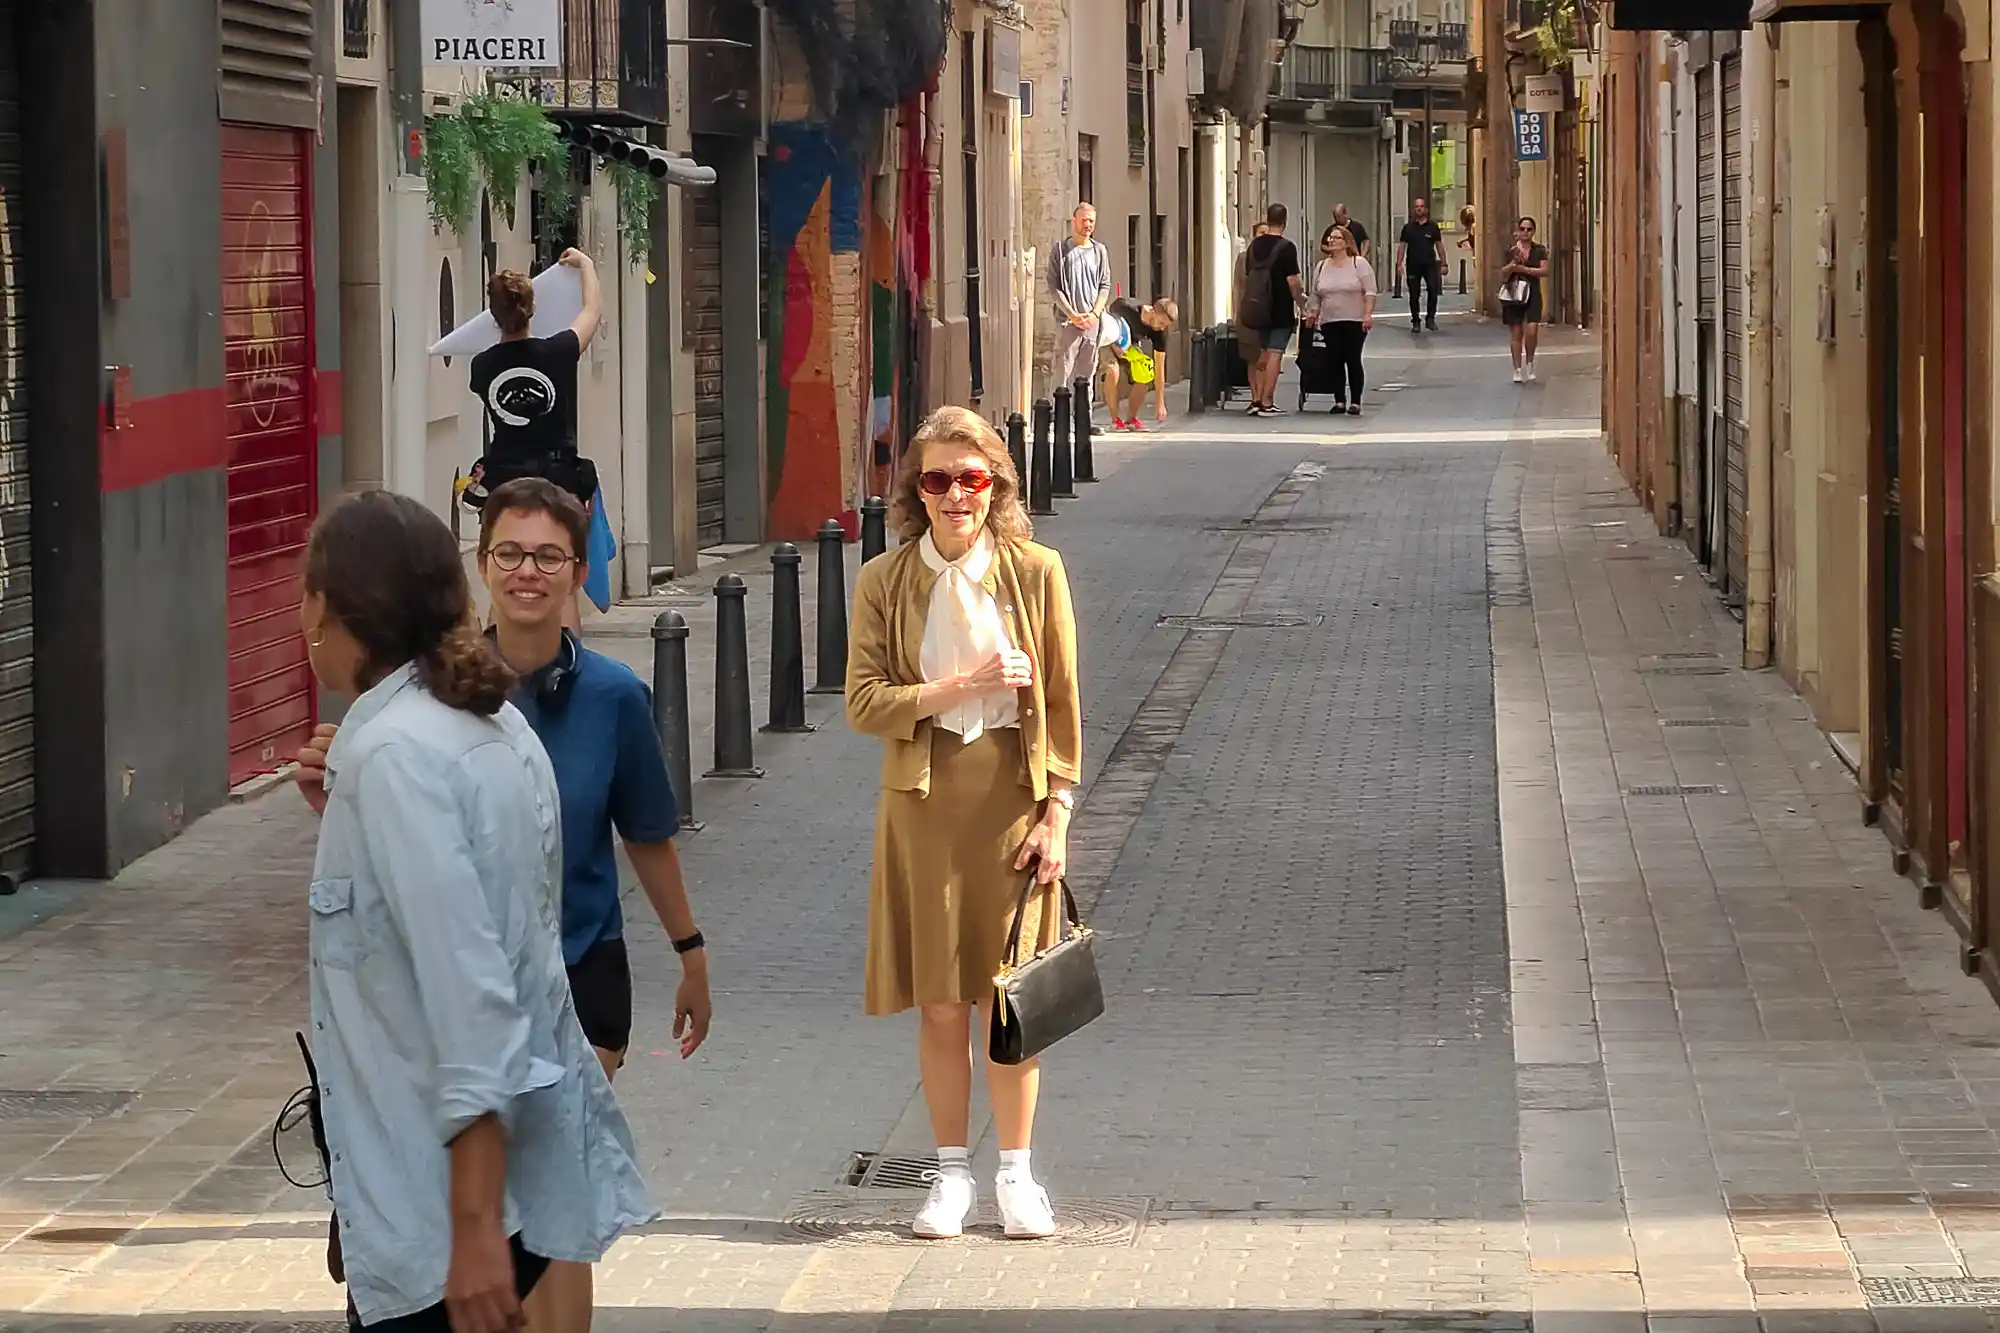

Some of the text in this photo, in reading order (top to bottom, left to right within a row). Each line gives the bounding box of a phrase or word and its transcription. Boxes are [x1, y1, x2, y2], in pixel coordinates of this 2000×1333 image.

[434, 38, 545, 60] PIACERI
[1519, 114, 1540, 123] PO
[1520, 124, 1540, 134] DO
[1520, 134, 1540, 144] LO
[1521, 145, 1541, 154] GA
